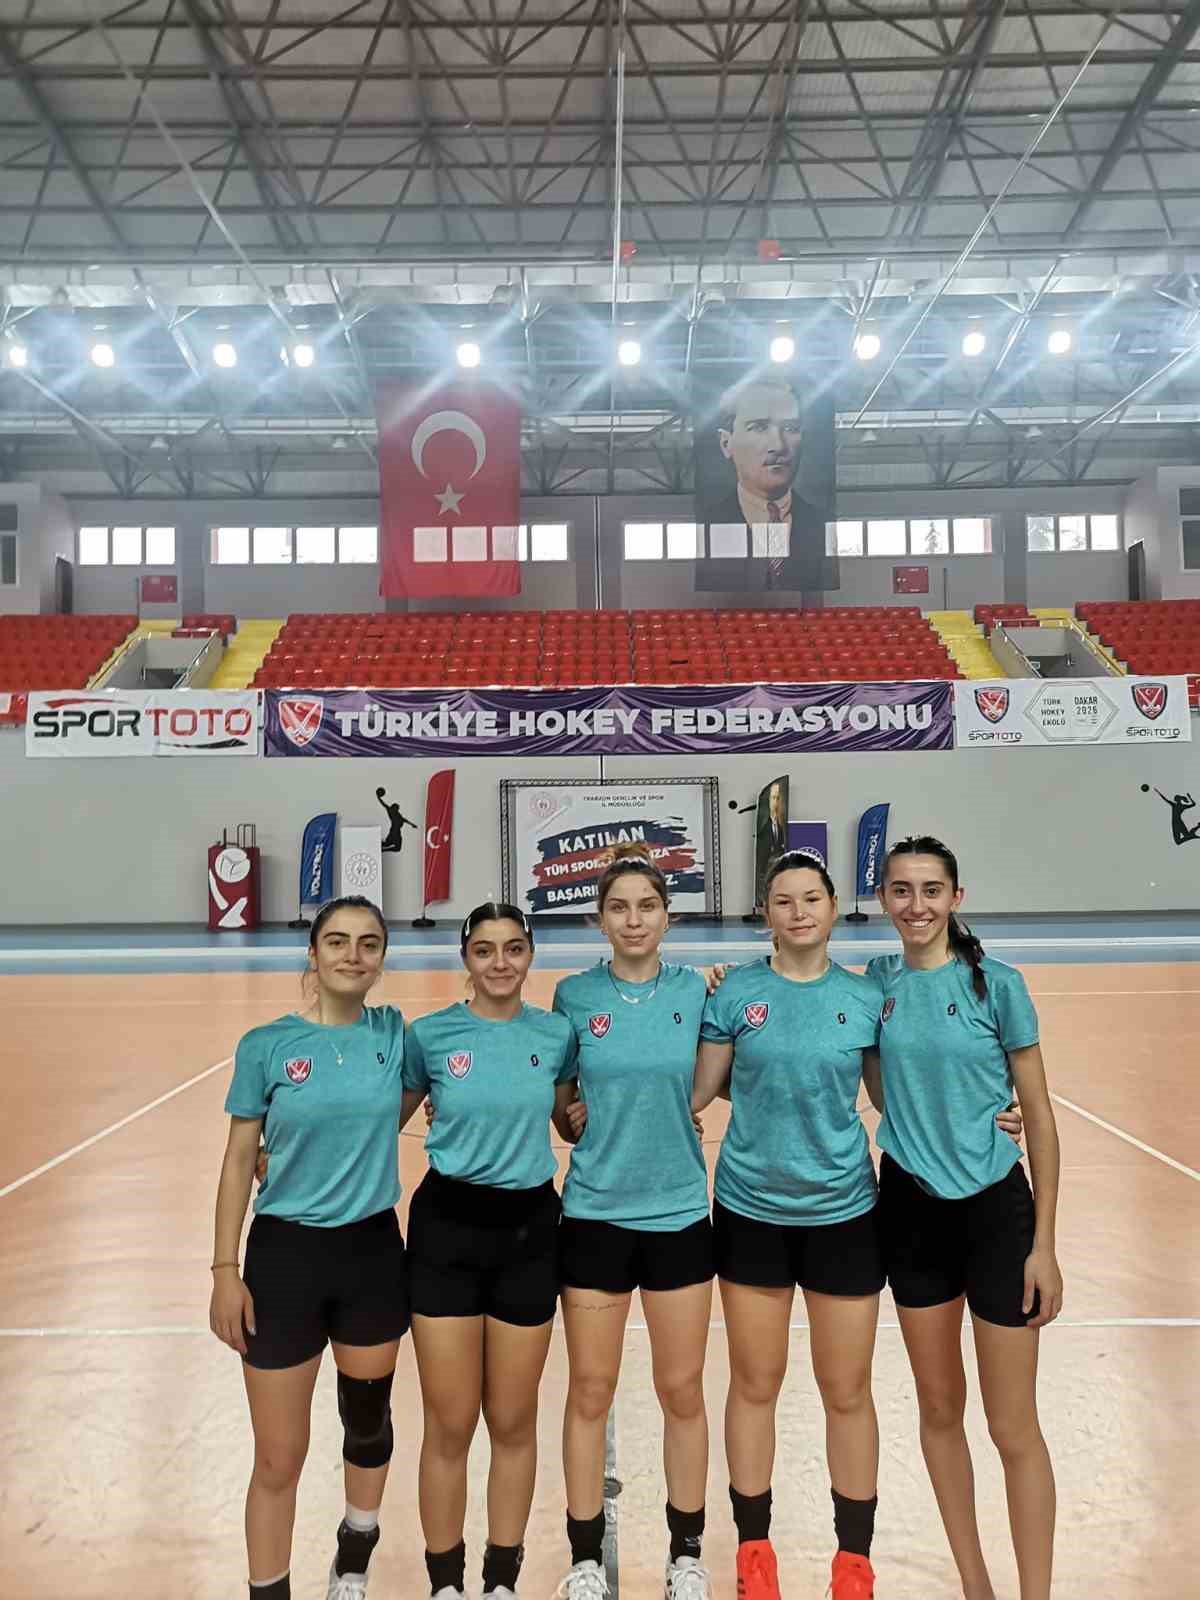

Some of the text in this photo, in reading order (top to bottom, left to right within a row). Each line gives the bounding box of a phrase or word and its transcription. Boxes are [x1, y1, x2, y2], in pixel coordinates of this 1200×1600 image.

[1074, 696, 1098, 705] DAKAR
[335, 703, 933, 738] TÜRKİYE HOKEY FEDERASYONU
[559, 826, 645, 853] KATILAN
[543, 860, 569, 878] TÜM
